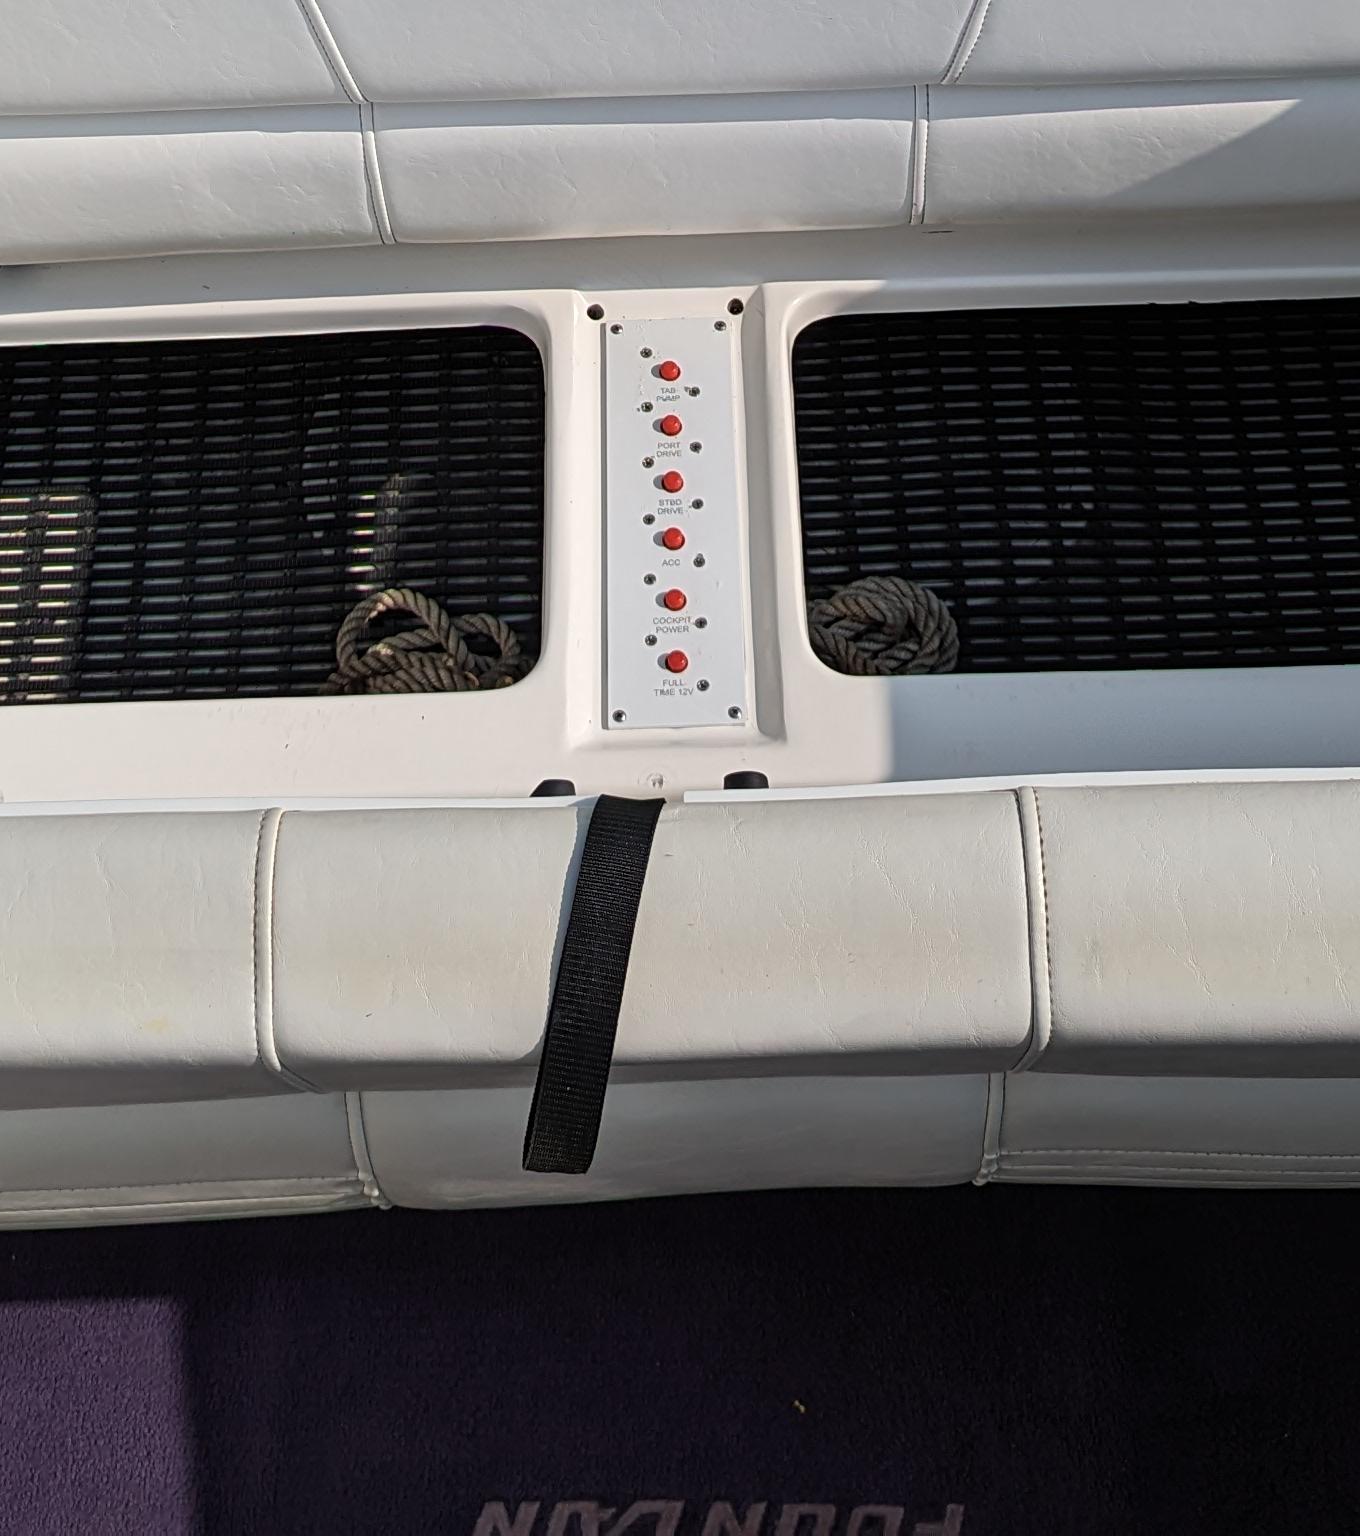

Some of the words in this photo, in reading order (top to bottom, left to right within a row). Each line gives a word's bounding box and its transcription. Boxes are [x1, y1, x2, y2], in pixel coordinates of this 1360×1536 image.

[658, 498, 682, 506] STBD
[657, 507, 684, 515] DRIVE
[661, 558, 681, 566] ACC
[652, 616, 692, 625] COCKPIT
[655, 625, 690, 634] POWER
[662, 679, 684, 687] FULL
[653, 688, 676, 697] TIME
[678, 687, 695, 696] 12V
